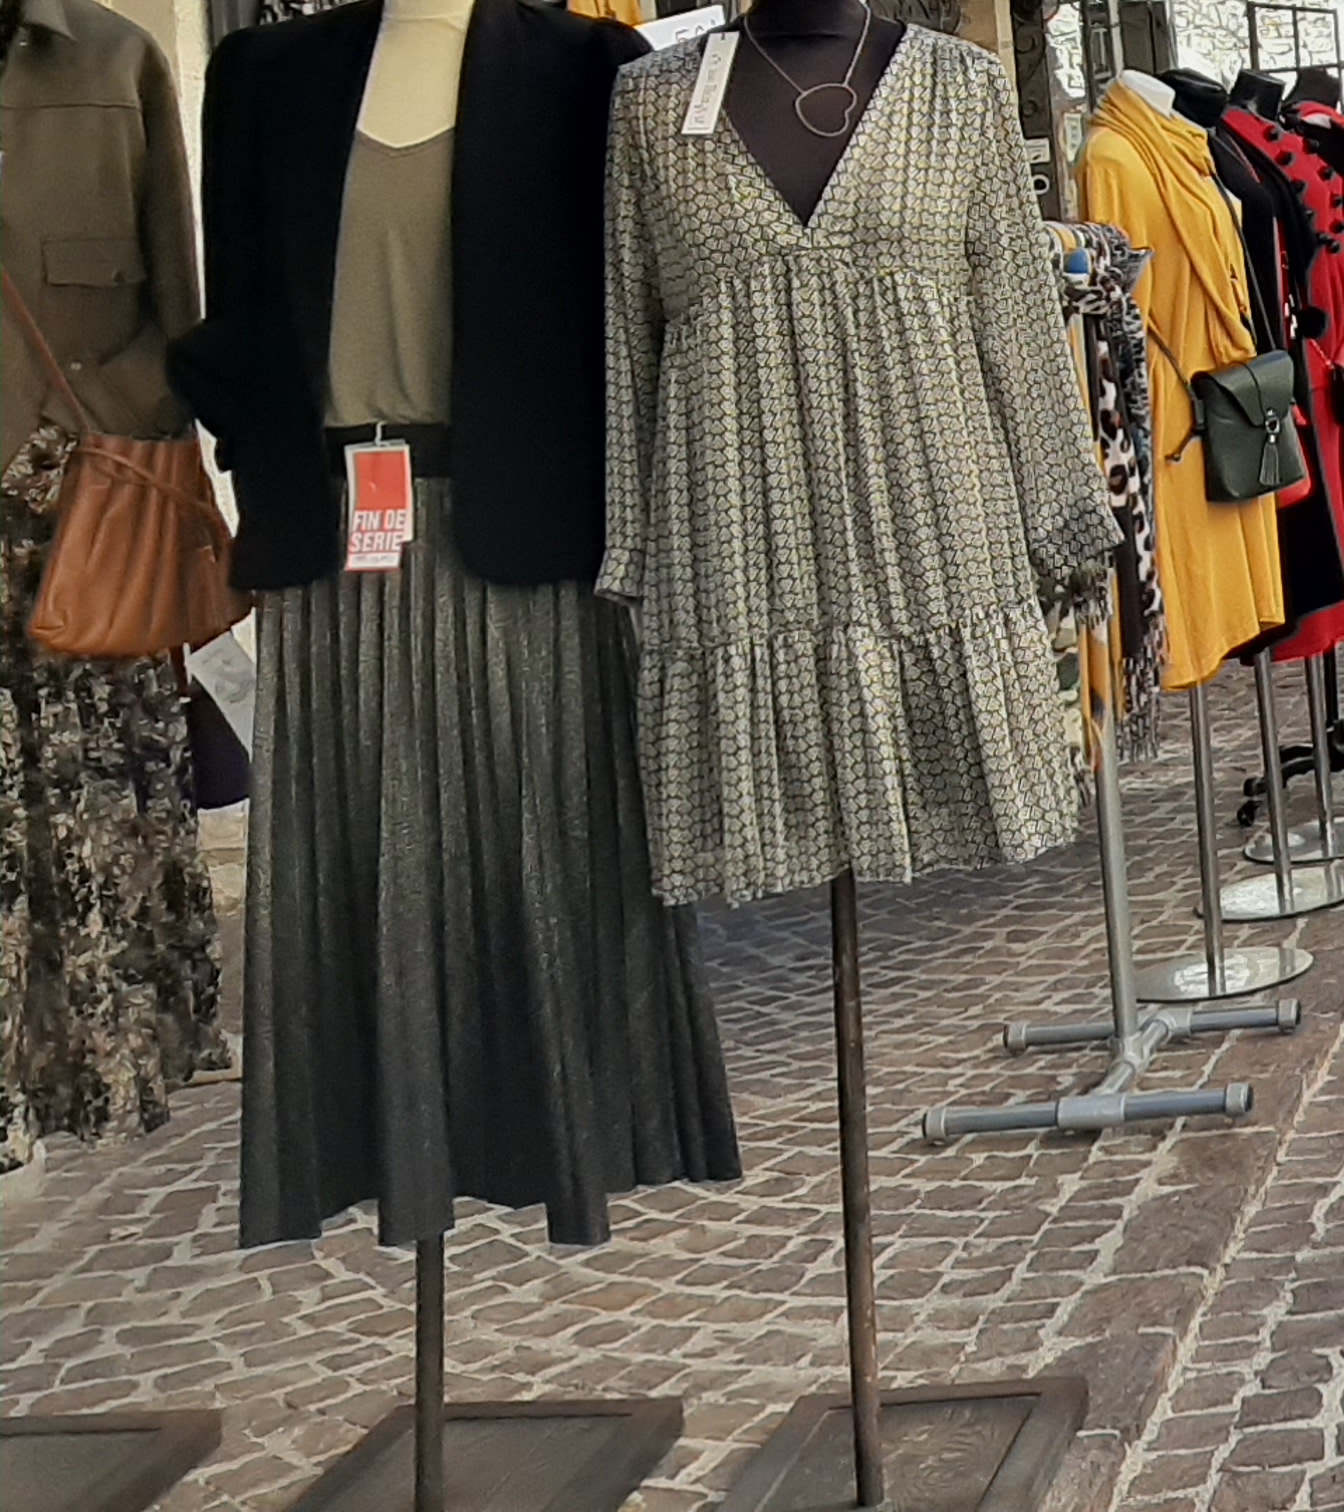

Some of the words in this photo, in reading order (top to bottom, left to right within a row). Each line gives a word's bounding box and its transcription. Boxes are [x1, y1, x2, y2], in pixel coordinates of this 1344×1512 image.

[353, 509, 382, 531] FIN
[383, 508, 406, 530] DE
[349, 531, 404, 553] SERIE
